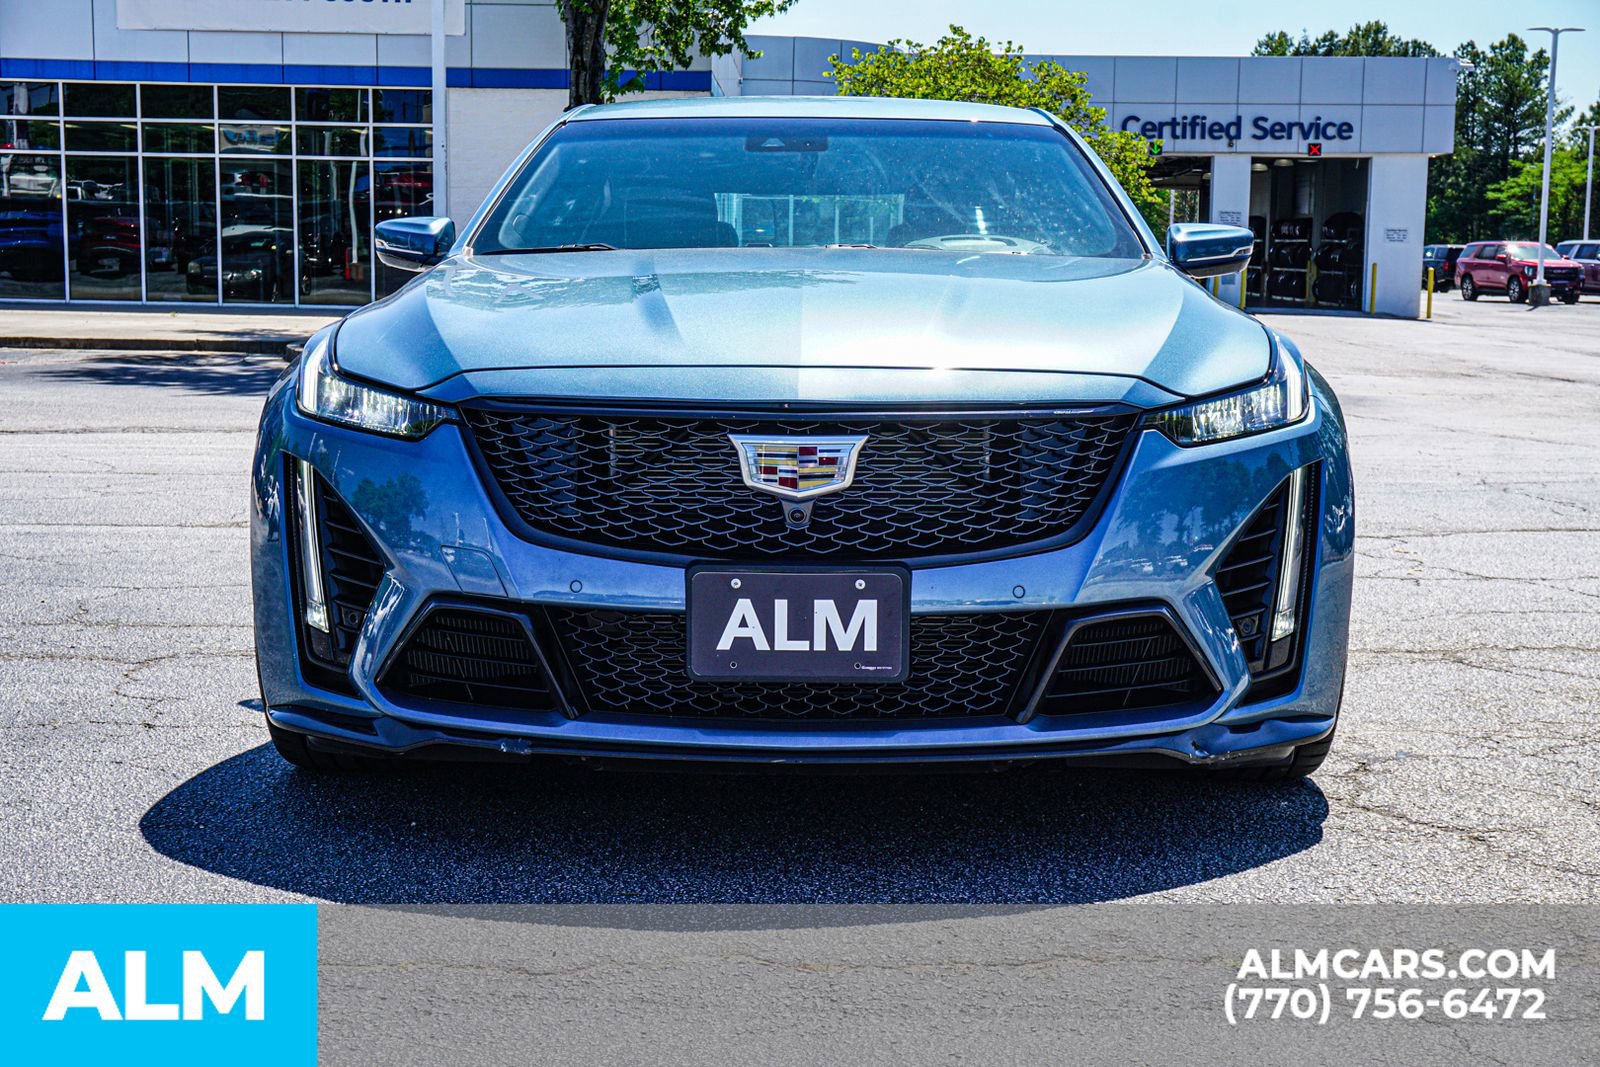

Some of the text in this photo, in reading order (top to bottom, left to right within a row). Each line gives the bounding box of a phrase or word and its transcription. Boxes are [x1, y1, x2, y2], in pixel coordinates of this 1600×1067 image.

[1121, 115, 1354, 141] Certified Service
[716, 598, 878, 651] ALM
